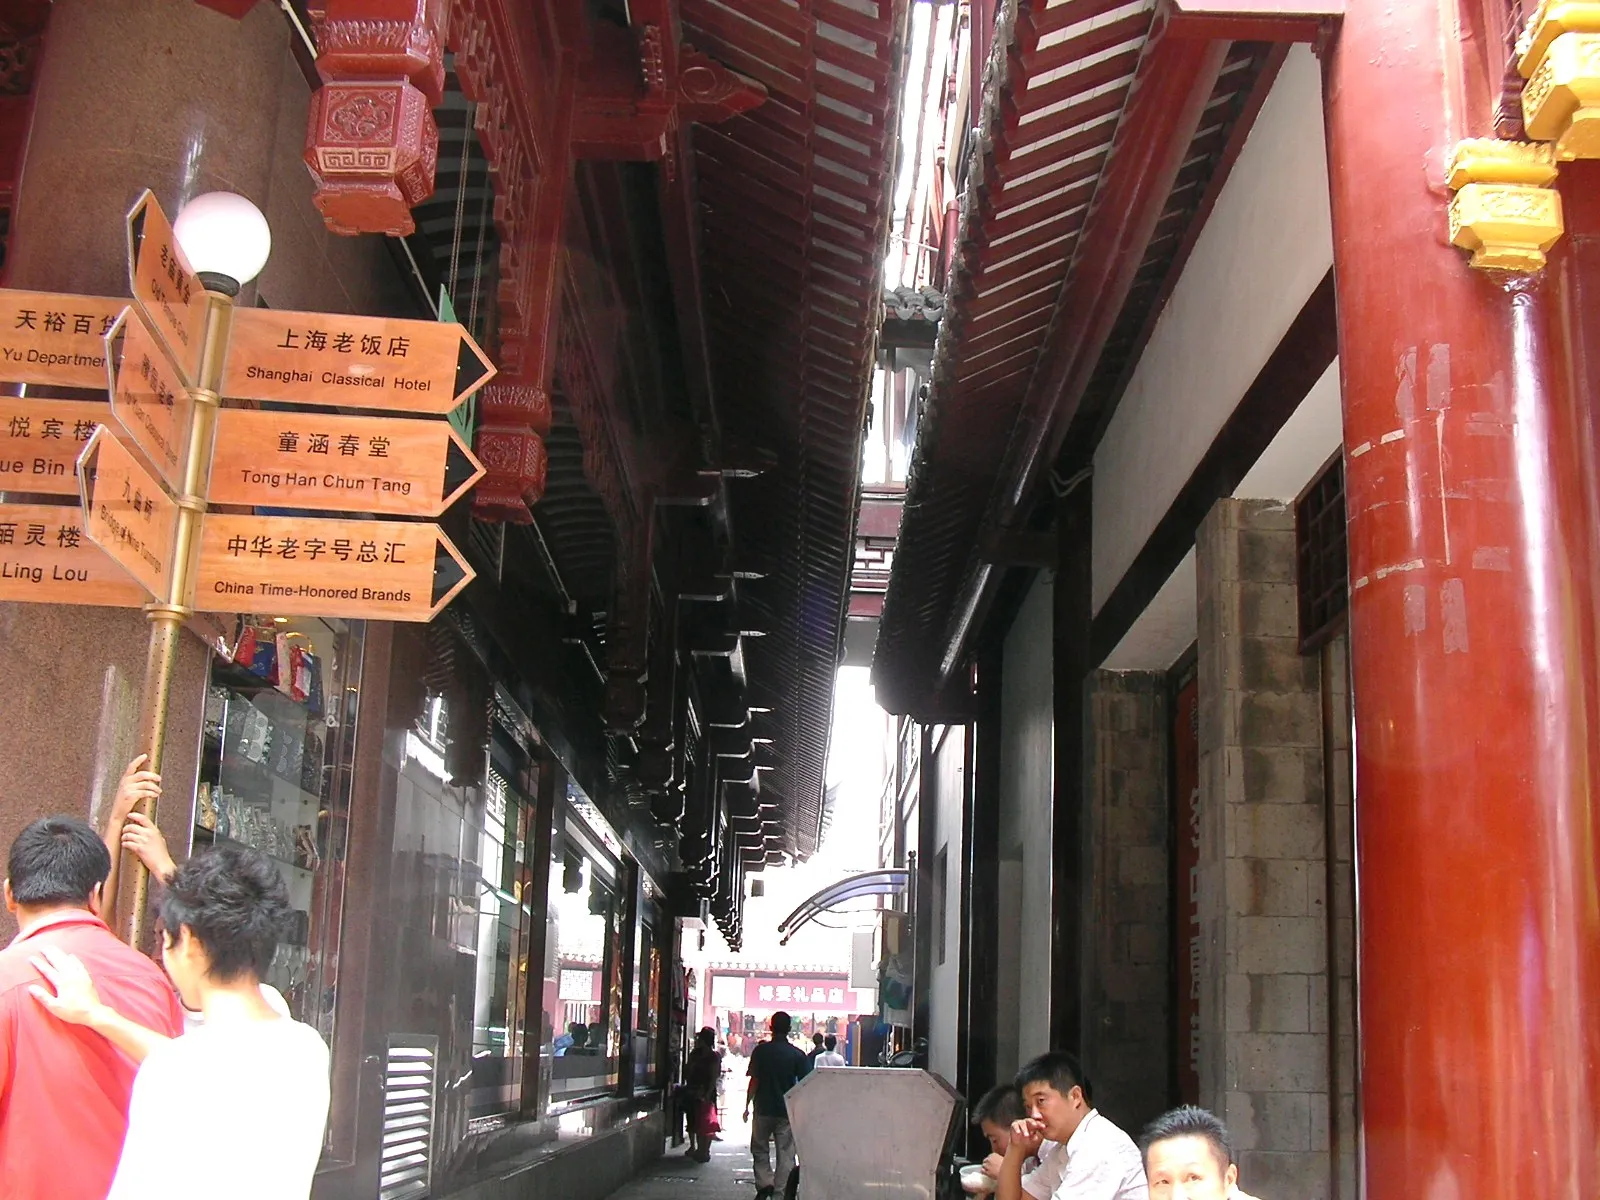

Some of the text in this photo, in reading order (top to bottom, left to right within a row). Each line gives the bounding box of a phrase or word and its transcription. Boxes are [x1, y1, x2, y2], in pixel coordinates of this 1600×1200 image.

[3, 348, 22, 361] Yu
[277, 328, 411, 358] 上海老饭店
[246, 367, 431, 391] Shanghai Classical Hotel
[9, 416, 98, 442] 悦宾楼
[277, 431, 391, 458] 童涵春堂
[33, 459, 65, 476] Bin
[241, 470, 411, 494] Tong Han Chun Tang
[227, 534, 406, 564] 中华老字号总汇
[3, 562, 88, 583] Ling Lou
[214, 581, 411, 602] China Time-Honored Brands
